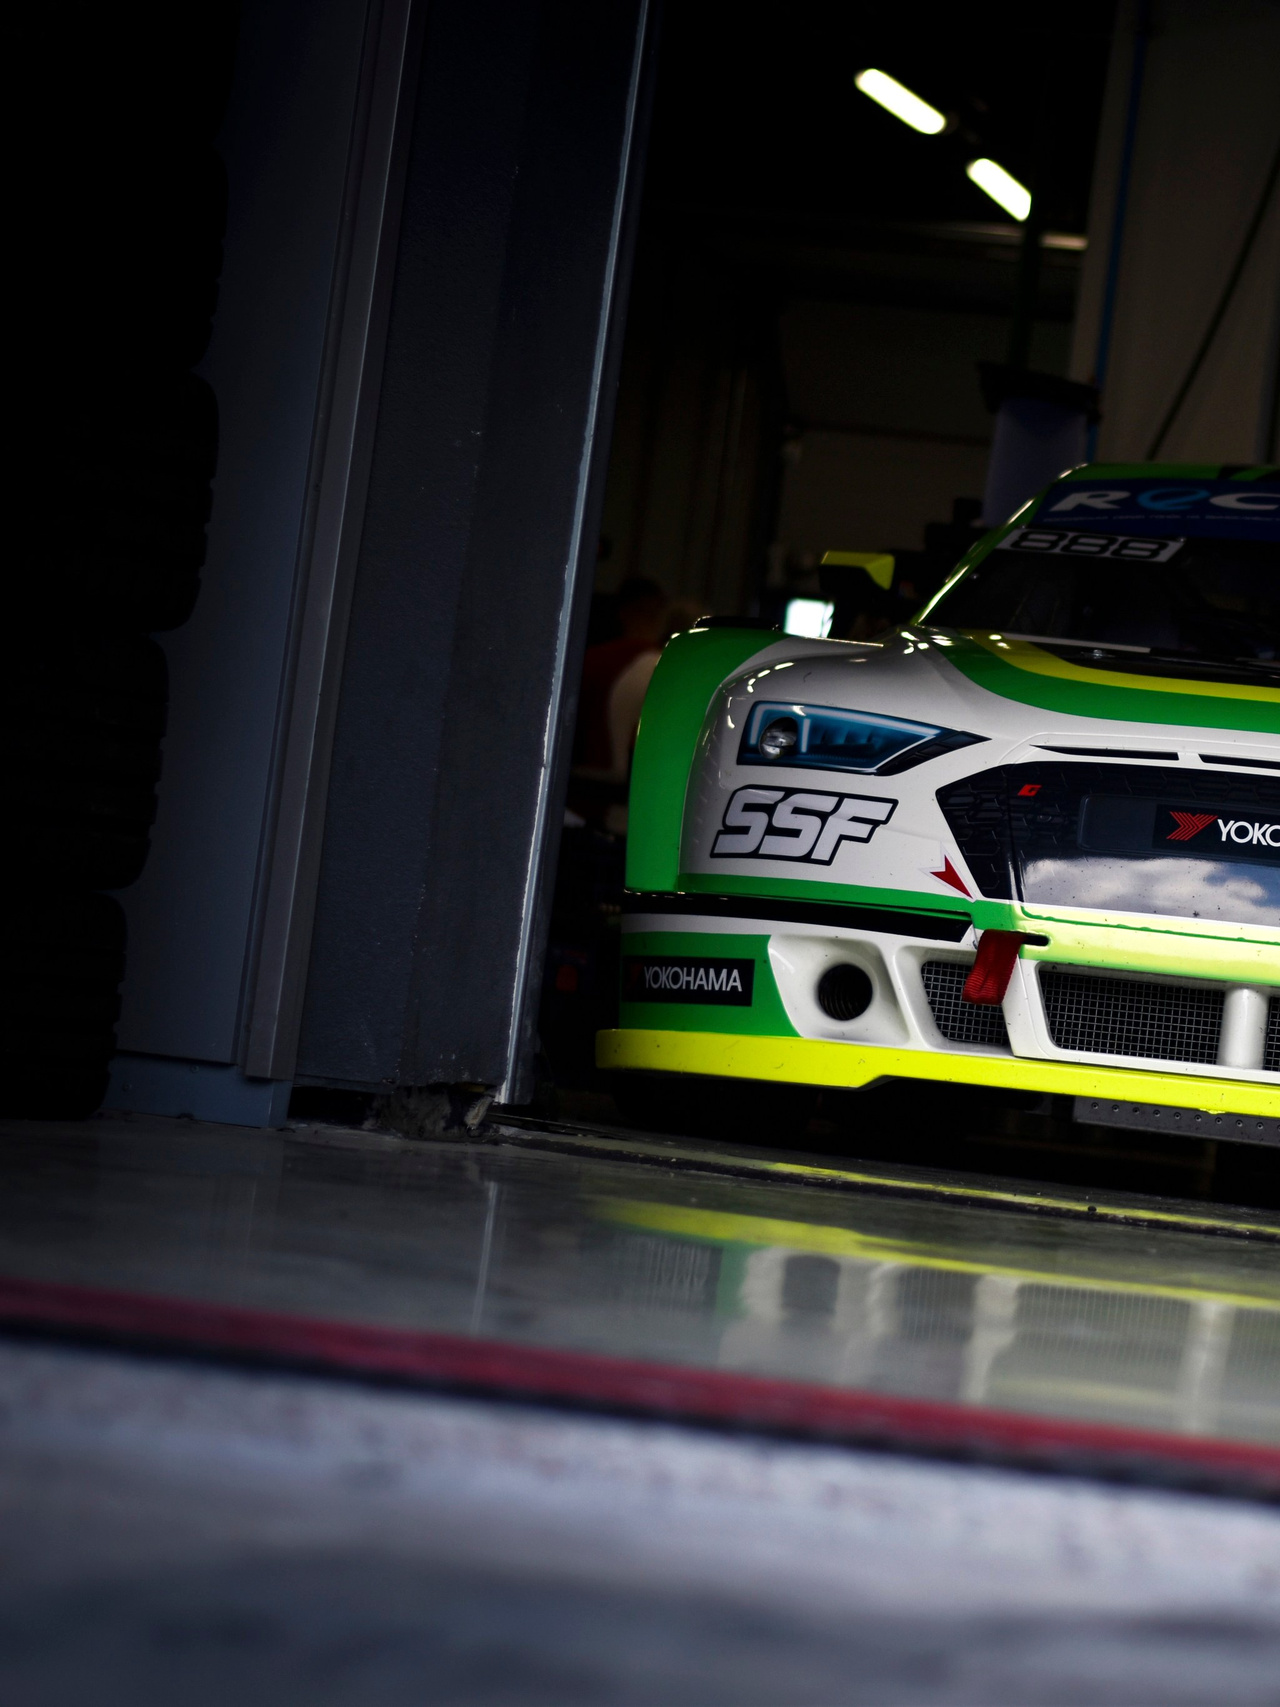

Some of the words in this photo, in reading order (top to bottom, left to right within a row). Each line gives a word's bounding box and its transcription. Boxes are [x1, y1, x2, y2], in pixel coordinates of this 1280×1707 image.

[1010, 531, 1169, 559] 888
[710, 784, 899, 866] SSF
[643, 965, 743, 992] YOKOHAMA
